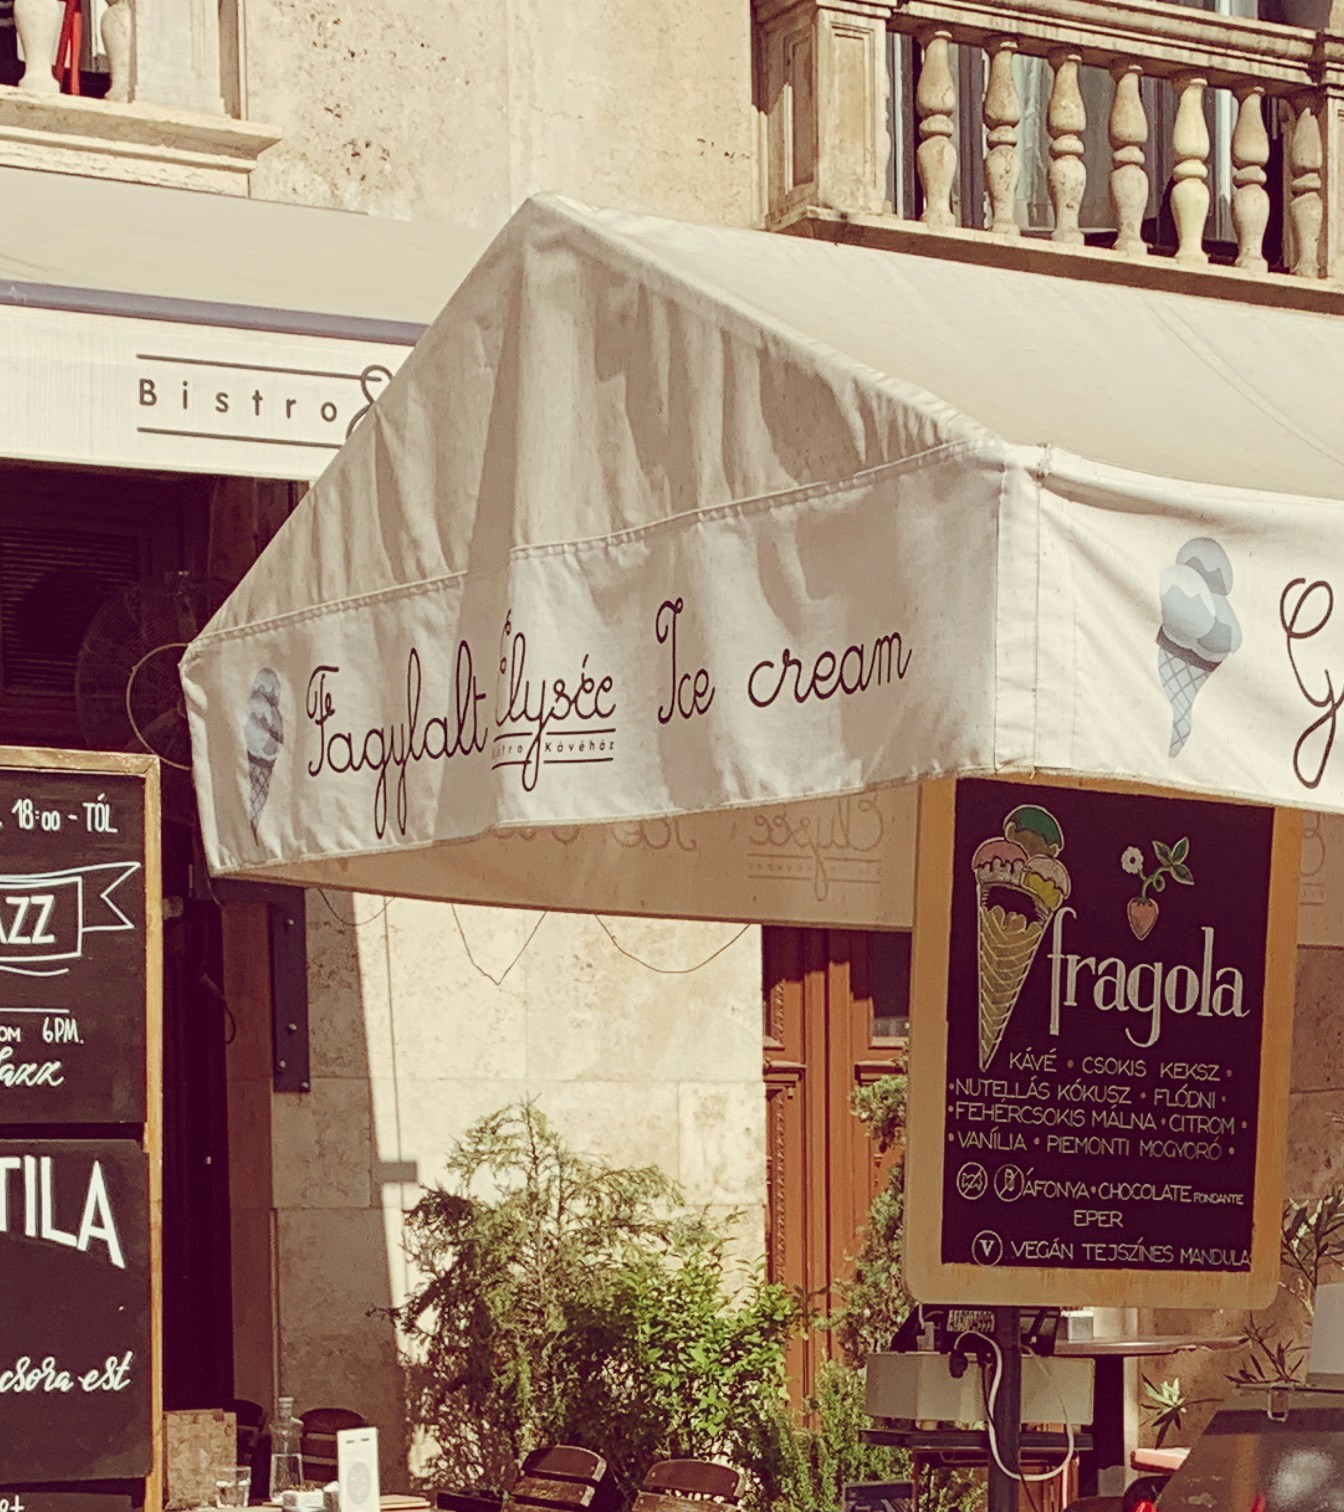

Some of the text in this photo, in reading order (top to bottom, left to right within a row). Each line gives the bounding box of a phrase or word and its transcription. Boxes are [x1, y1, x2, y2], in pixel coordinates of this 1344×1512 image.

[138, 379, 338, 424] Bistro
[308, 597, 913, 839] Fagylalt Ice cream
[1047, 907, 1251, 1047] fragola
[1009, 1047, 1221, 1081] KÁVÉ CSOKIS KEKSZ
[956, 1075, 1216, 1109] NUTELLÁS KÓKUSZ FLÓDNI
[956, 1100, 1235, 1136] FEHÉRCSOKIS MÁLNA CITROM
[957, 1121, 1028, 1151] VANÍLIA
[1047, 1135, 1130, 1156] PIEMONTI
[1023, 1167, 1090, 1199] ÁFONYA
[1098, 1183, 1193, 1203] CHOCOLATE
[1074, 1210, 1123, 1228] EPER
[1010, 1237, 1074, 1261] VEGÁN
[1082, 1237, 1174, 1264] TEJSZÍNES
[1179, 1249, 1251, 1266] MANDULA
[78, 1351, 133, 1390] est
